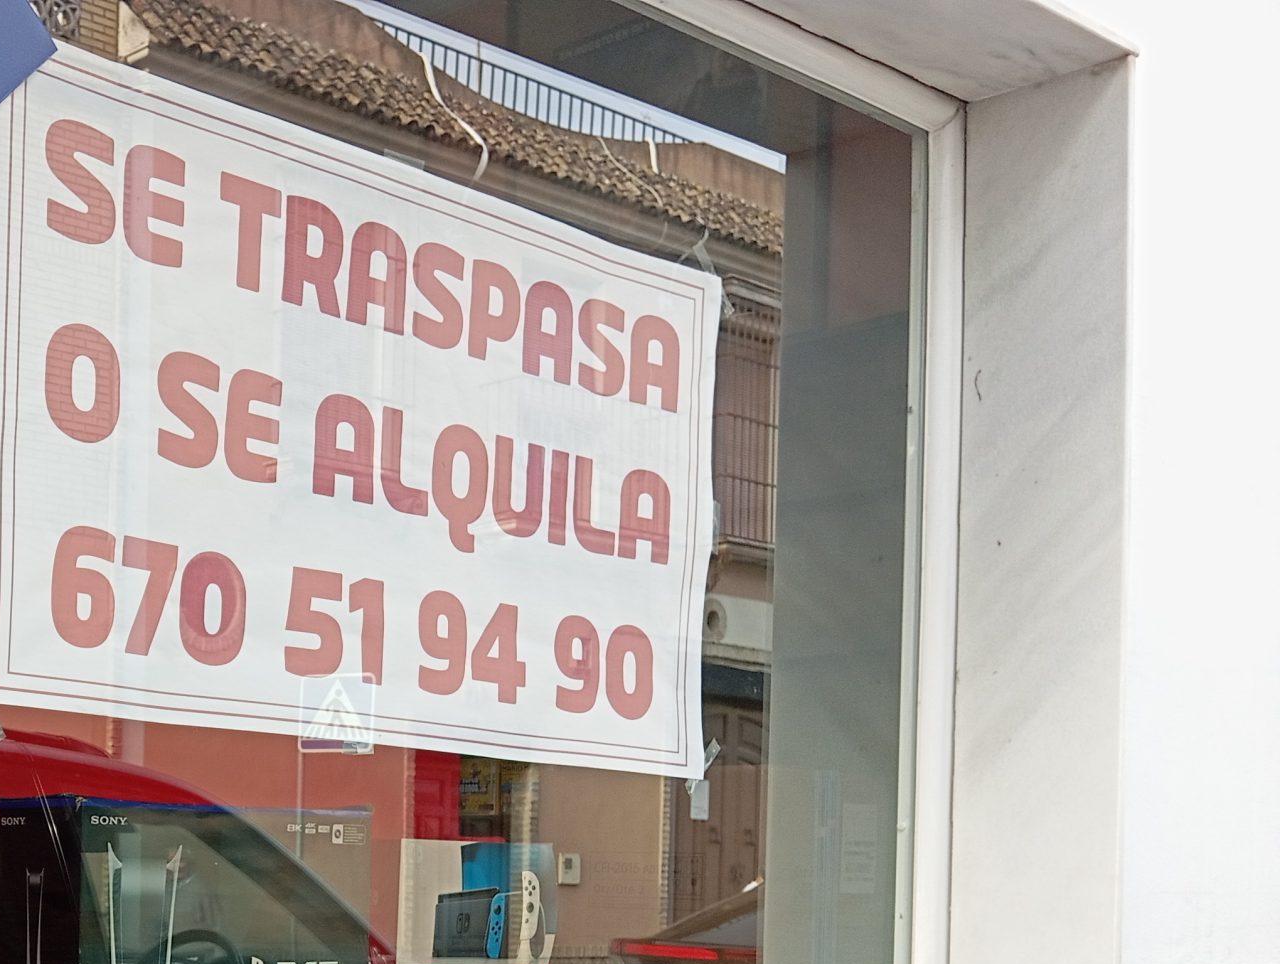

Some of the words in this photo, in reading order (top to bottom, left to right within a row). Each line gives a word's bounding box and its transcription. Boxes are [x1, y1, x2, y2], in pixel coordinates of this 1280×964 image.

[45, 118, 186, 268] SE
[219, 170, 681, 413] TRASPASA
[44, 323, 121, 443] O
[156, 351, 284, 484] SE
[311, 393, 672, 565] ALQUILA
[50, 525, 247, 667] 670
[283, 566, 385, 686] 51
[418, 590, 526, 705] 94
[553, 615, 654, 720] 90
[1, 816, 26, 826] SONY
[90, 815, 128, 826] SONY
